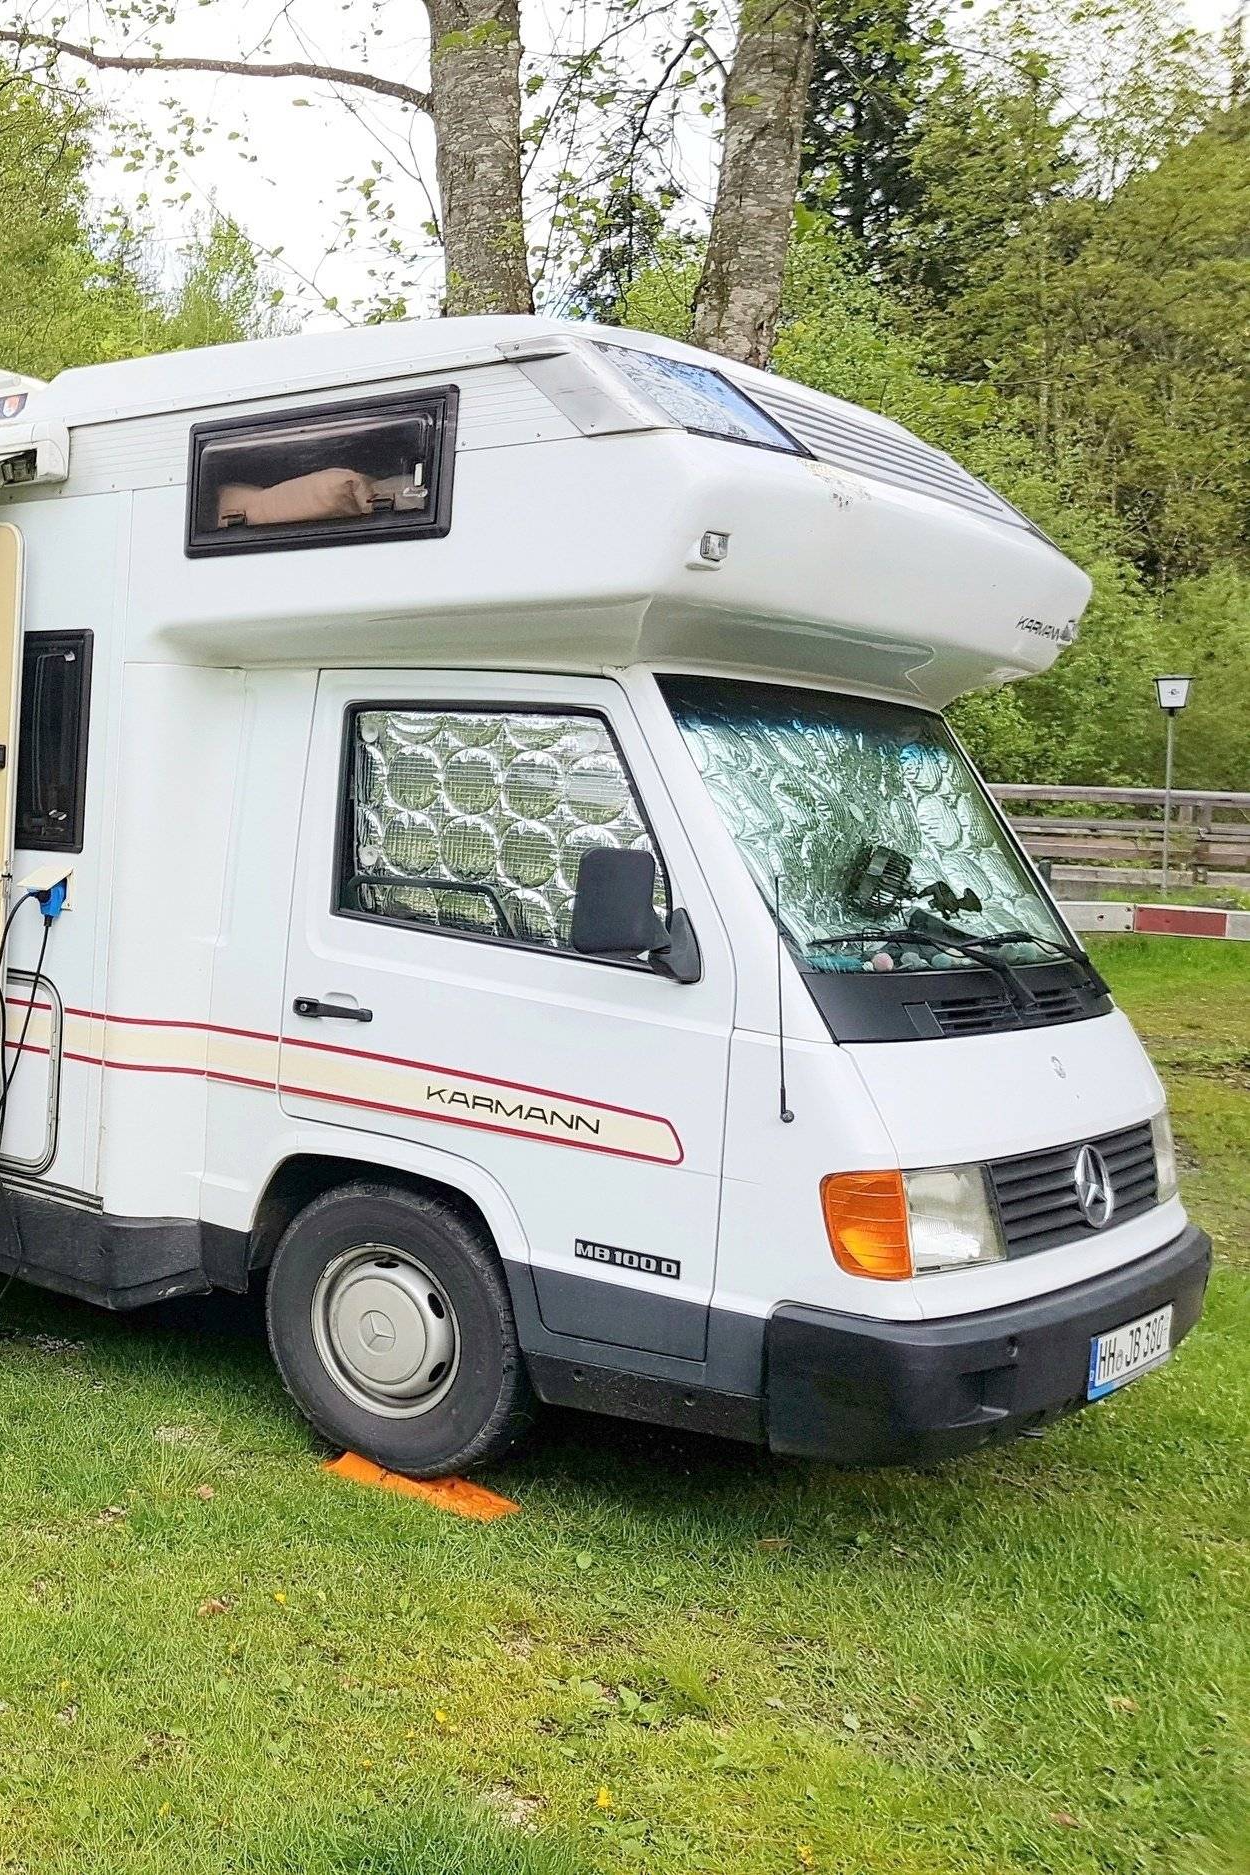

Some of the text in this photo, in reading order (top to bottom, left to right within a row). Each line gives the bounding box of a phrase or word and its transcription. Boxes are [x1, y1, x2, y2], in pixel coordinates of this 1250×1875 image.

[426, 1085, 601, 1135] KARMANN
[576, 1242, 678, 1276] MB 100 D
[1098, 1336, 1118, 1381] HH
[1124, 1326, 1142, 1367] JB
